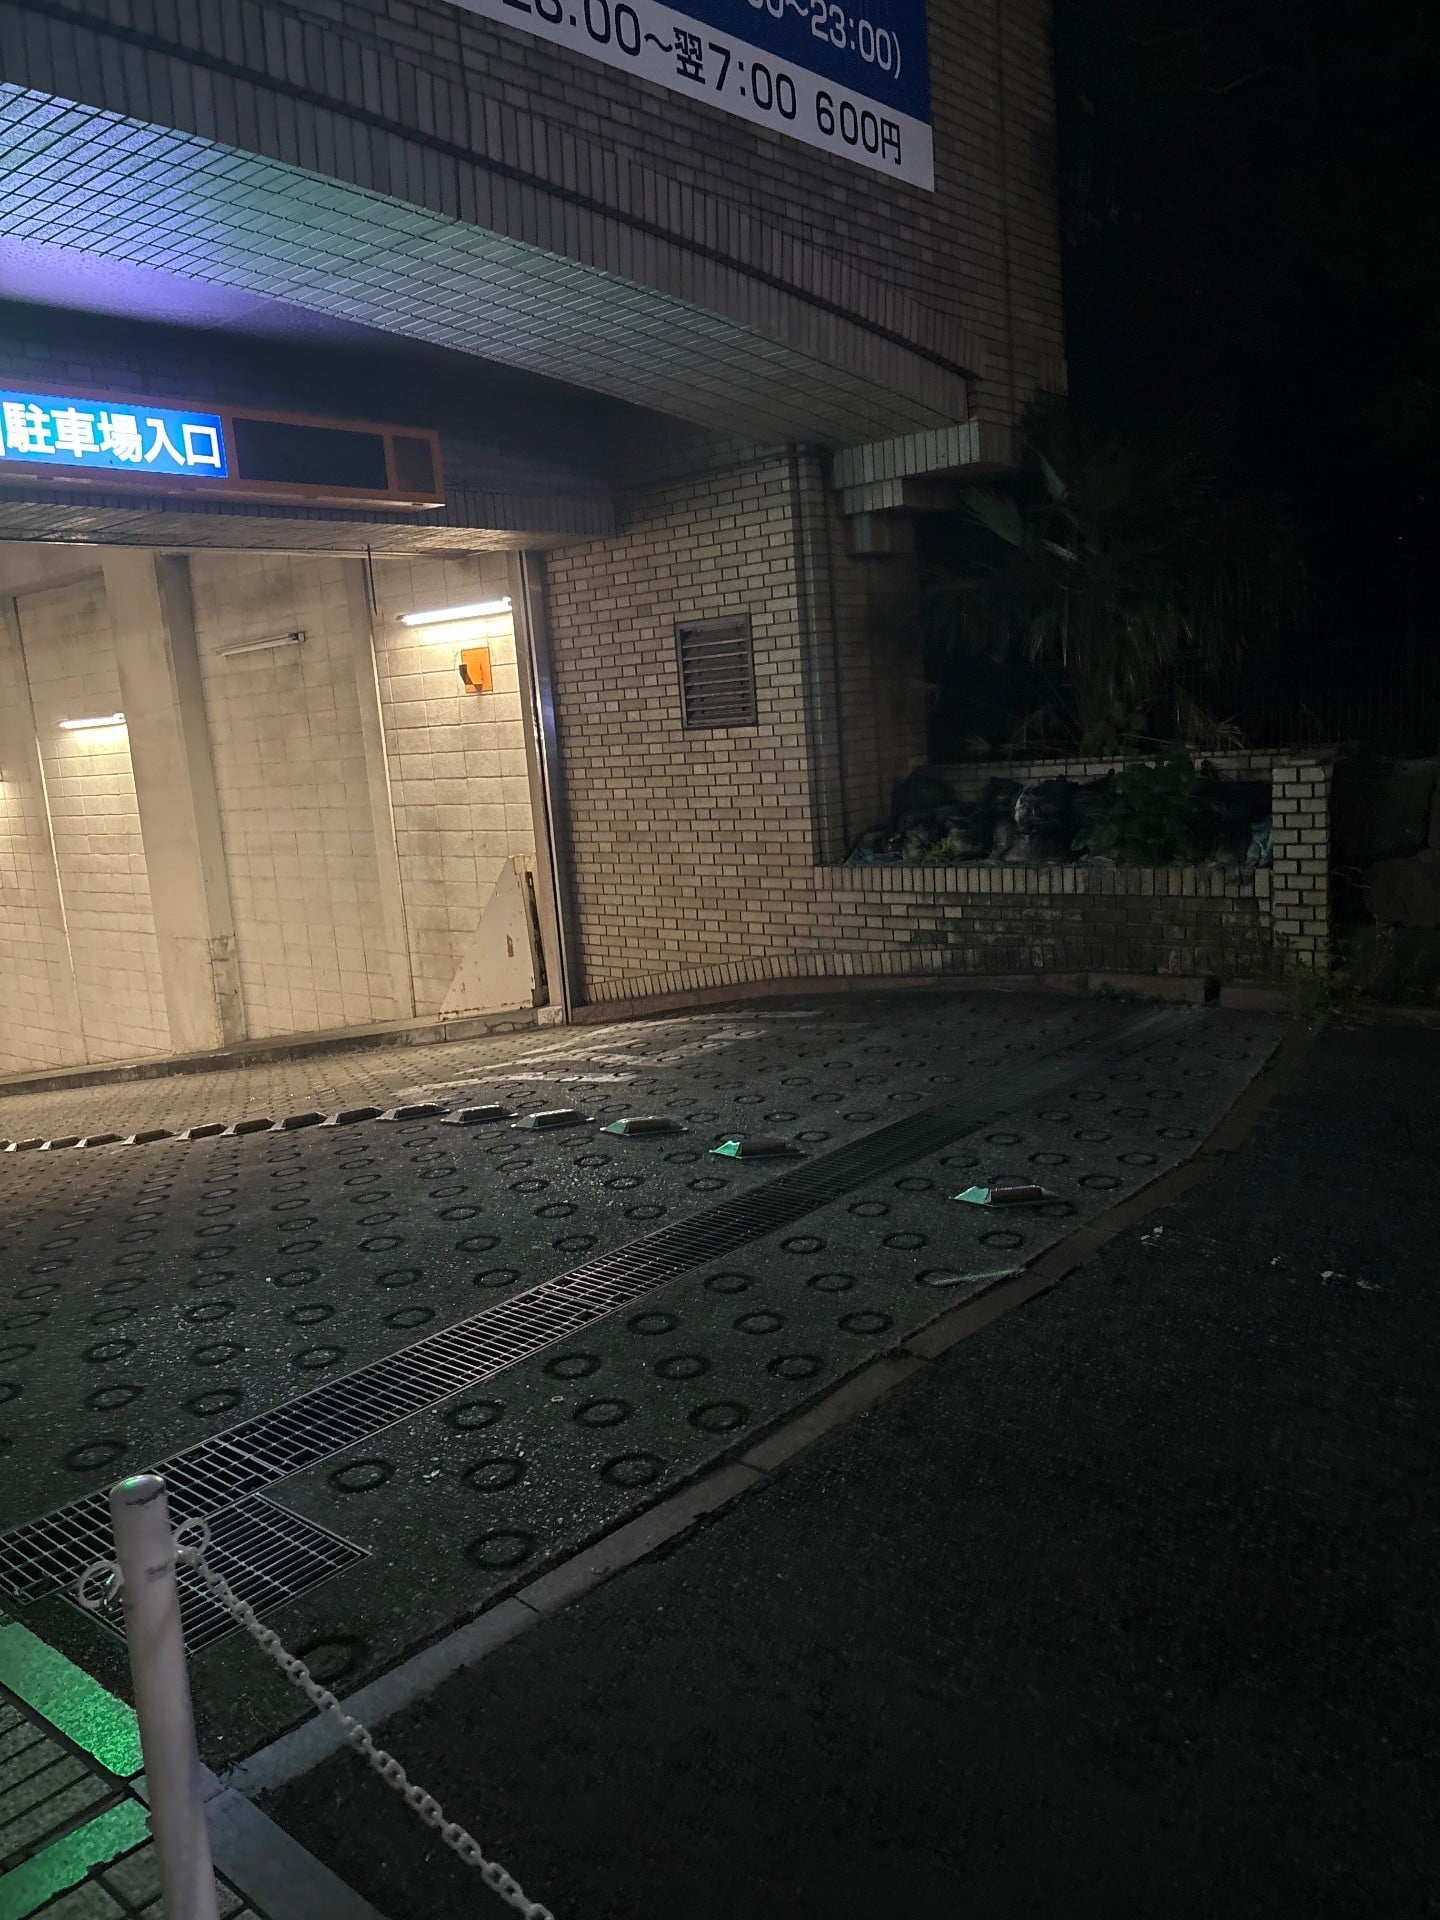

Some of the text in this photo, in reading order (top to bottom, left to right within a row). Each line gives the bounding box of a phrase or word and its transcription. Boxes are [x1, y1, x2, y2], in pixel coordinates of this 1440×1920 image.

[815, 90, 902, 165] 600円
[0, 401, 221, 468] 駐車場入口
